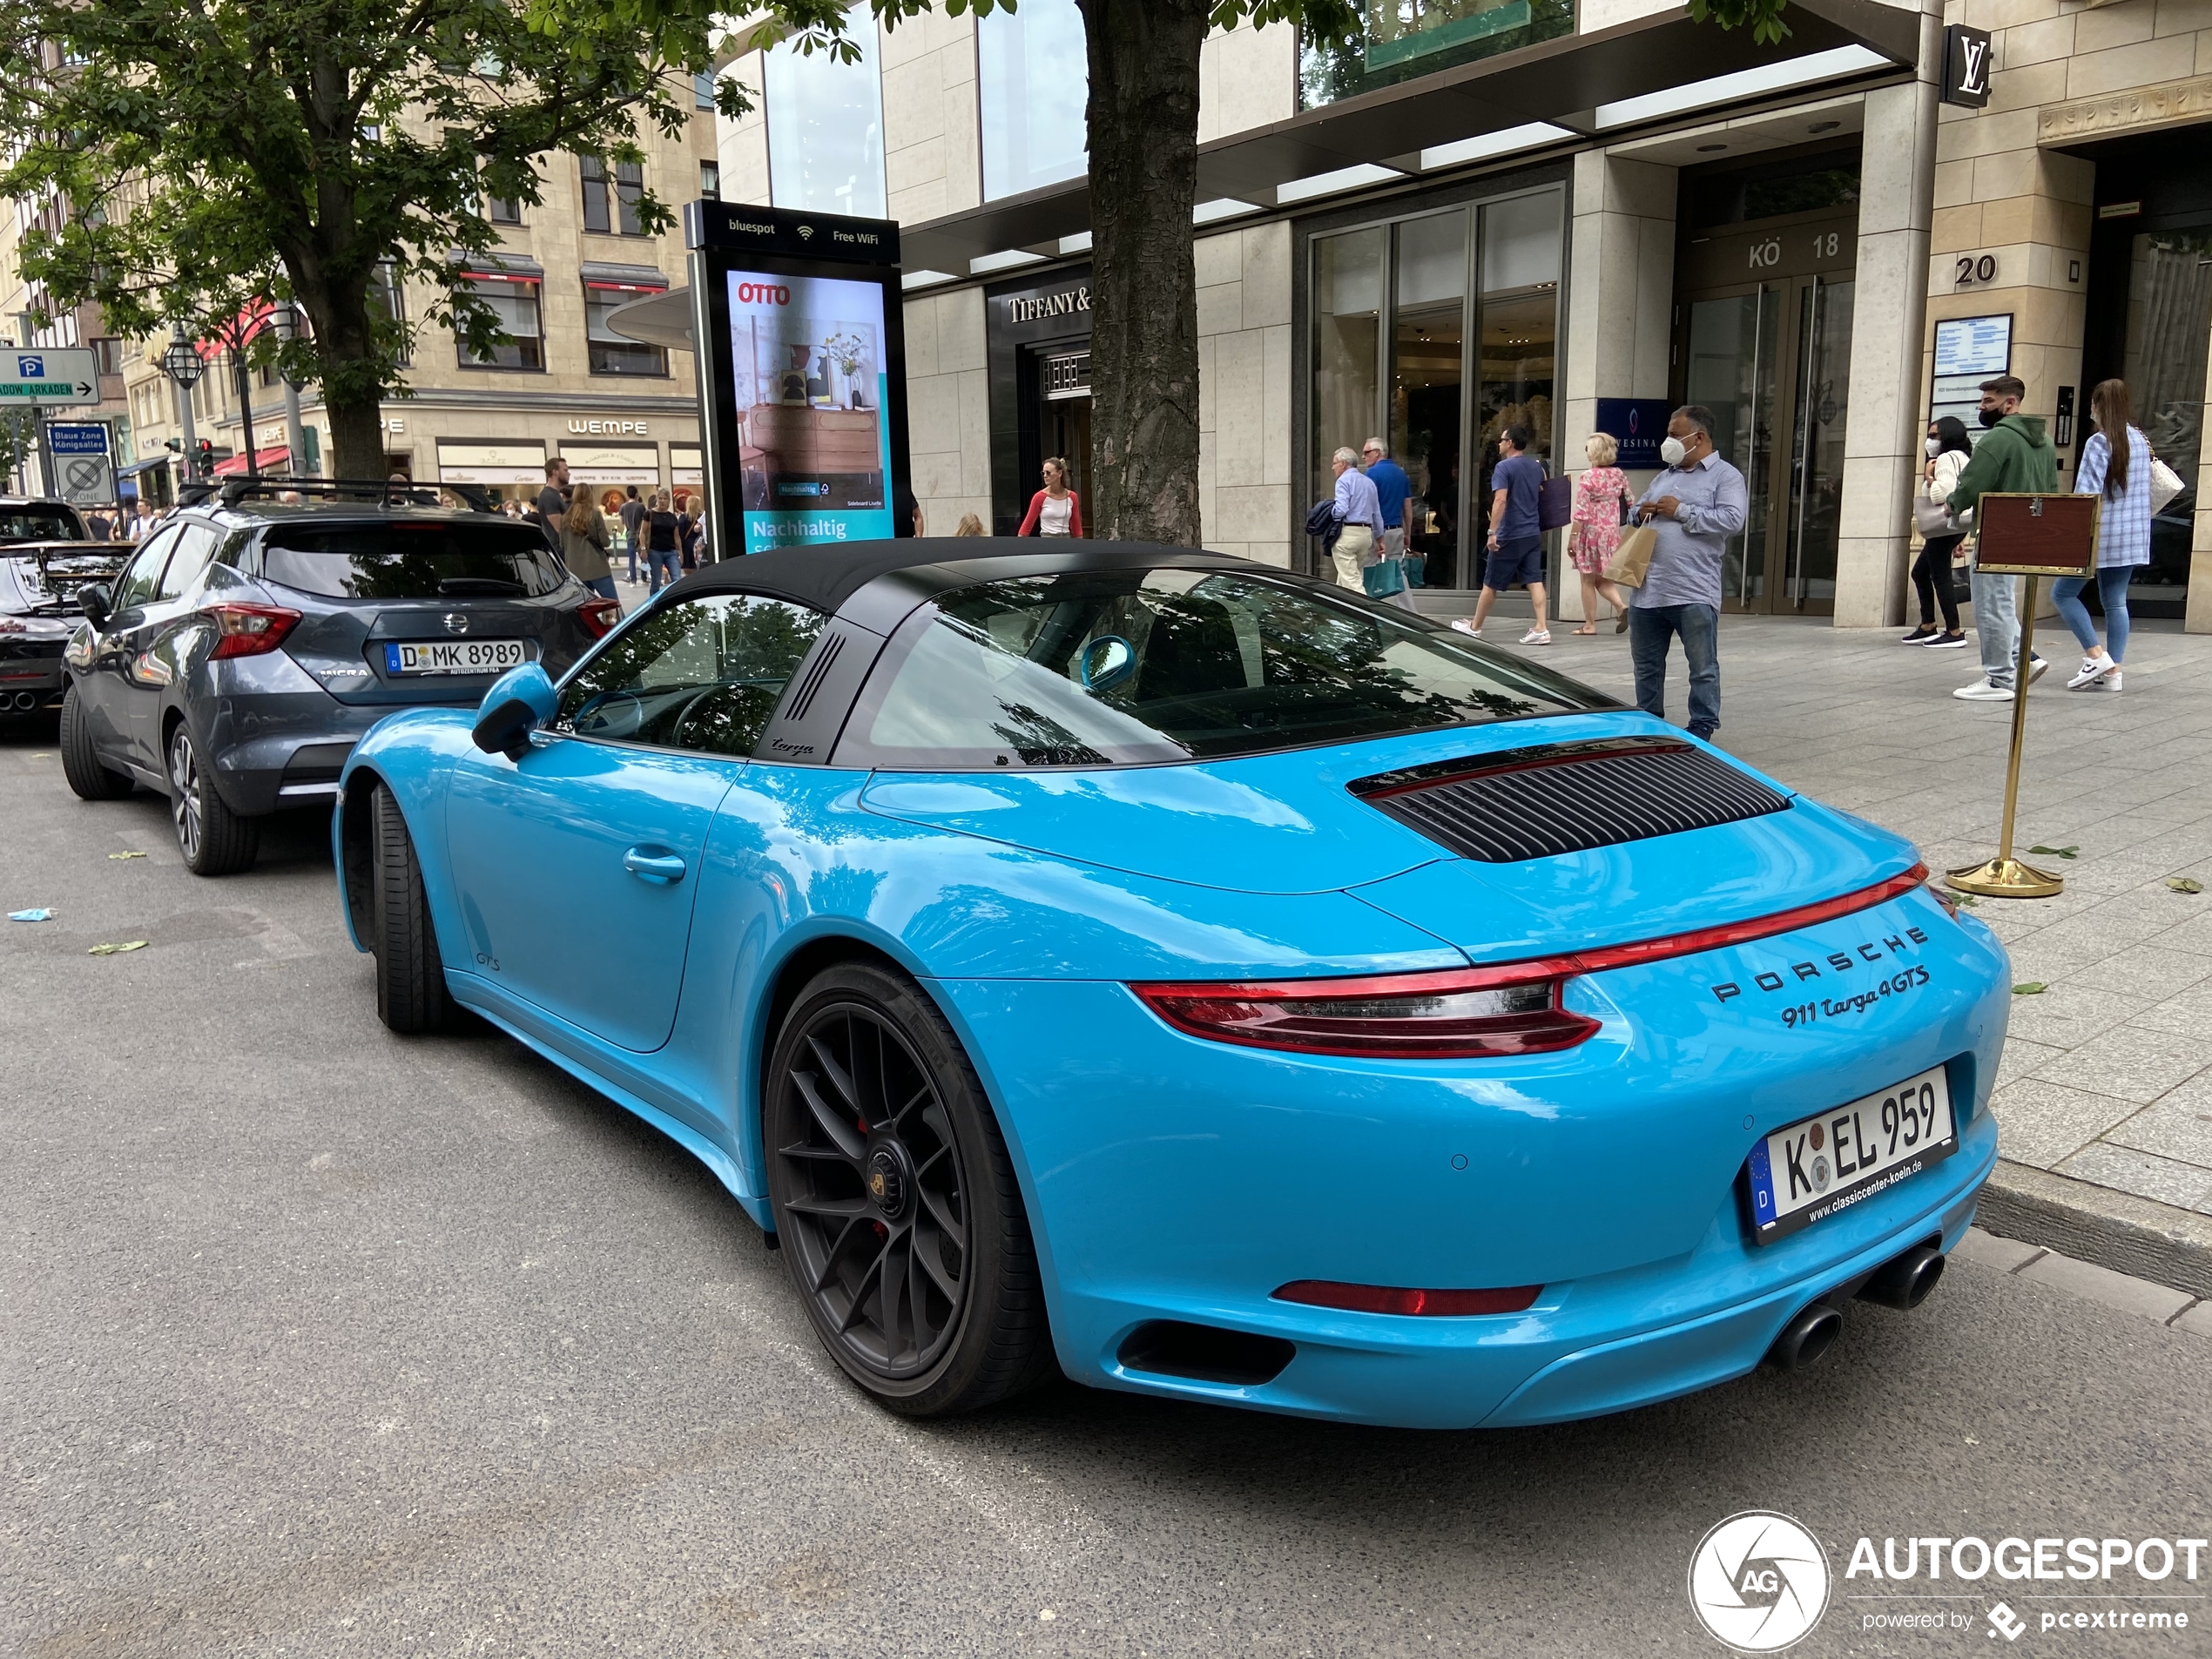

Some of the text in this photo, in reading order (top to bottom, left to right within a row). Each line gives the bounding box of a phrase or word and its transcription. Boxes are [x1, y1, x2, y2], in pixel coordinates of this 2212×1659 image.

[729, 219, 775, 235] bluespot
[833, 231, 879, 245] Free WiFi
[1749, 233, 1838, 268] KÖ 18
[1956, 254, 1997, 284] 20
[738, 282, 791, 306] OTTO
[1008, 291, 1076, 323] TIFFANY
[30, 384, 72, 395] ARKADEN
[55, 431, 101, 440] Blaue Zone
[568, 419, 647, 435] WEMPE
[55, 440, 103, 449] Königsallee
[752, 519, 846, 539] Nachhaltig
[401, 644, 522, 668] D MK 8989
[476, 953, 500, 971] GTS
[1711, 927, 1929, 1002] PORSCHE
[1781, 1001, 1817, 1028] 911
[1785, 1082, 1935, 1200] K EL 959
[1758, 1190, 1768, 1209] D
[1809, 1159, 1923, 1222] www.classiccenter-koeln.de
